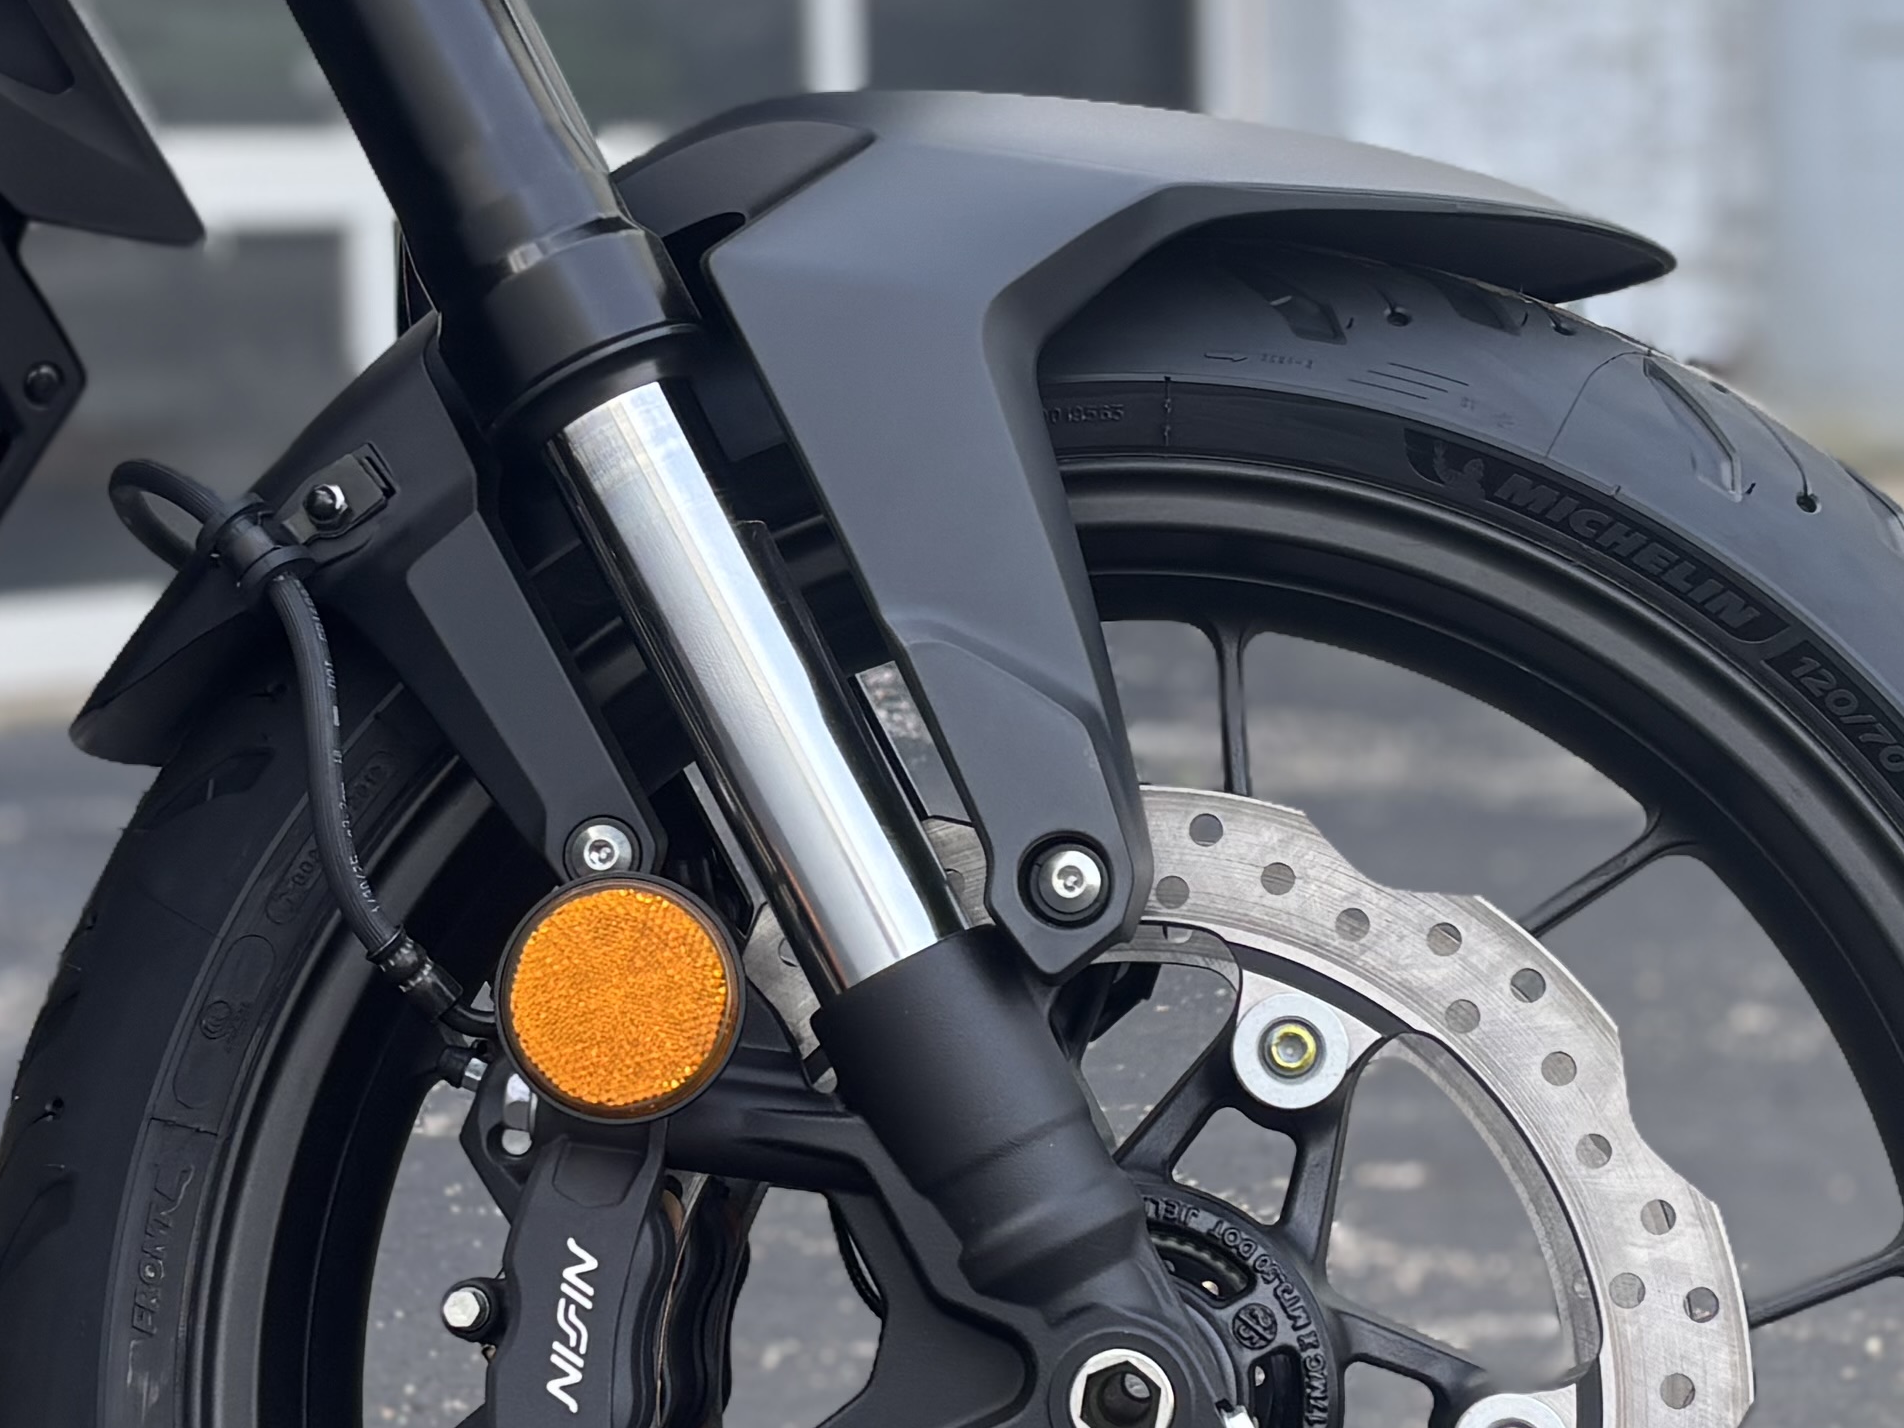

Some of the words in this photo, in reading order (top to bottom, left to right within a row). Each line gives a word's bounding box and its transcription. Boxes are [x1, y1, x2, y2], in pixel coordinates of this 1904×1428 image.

[1495, 475, 1764, 637] MICHELIN
[1213, 1219, 1259, 1259] DOT
[546, 1236, 598, 1413] NISSIN
